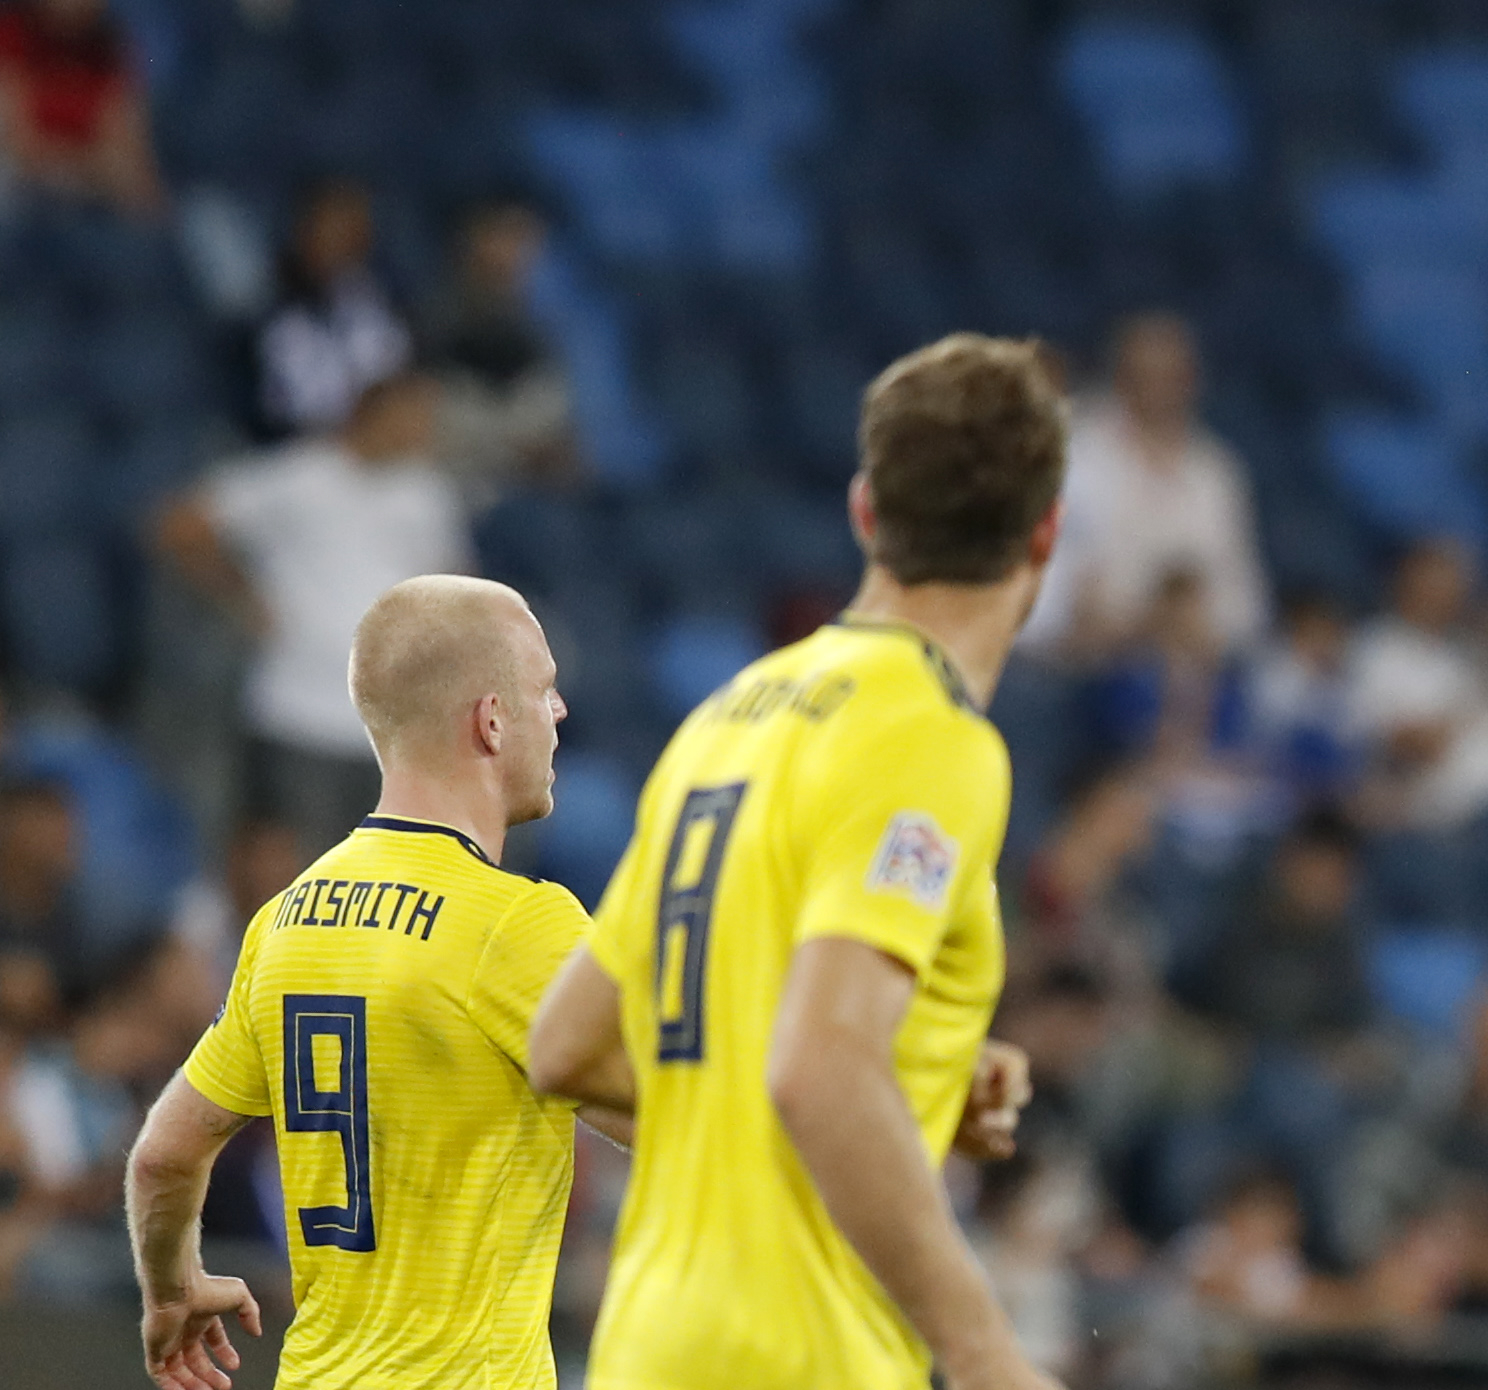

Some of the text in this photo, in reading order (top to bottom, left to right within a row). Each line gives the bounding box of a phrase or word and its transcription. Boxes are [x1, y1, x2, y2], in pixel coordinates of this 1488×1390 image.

[274, 879, 445, 941] NAISMITH
[655, 780, 748, 1063] 8
[282, 994, 376, 1252] 9
